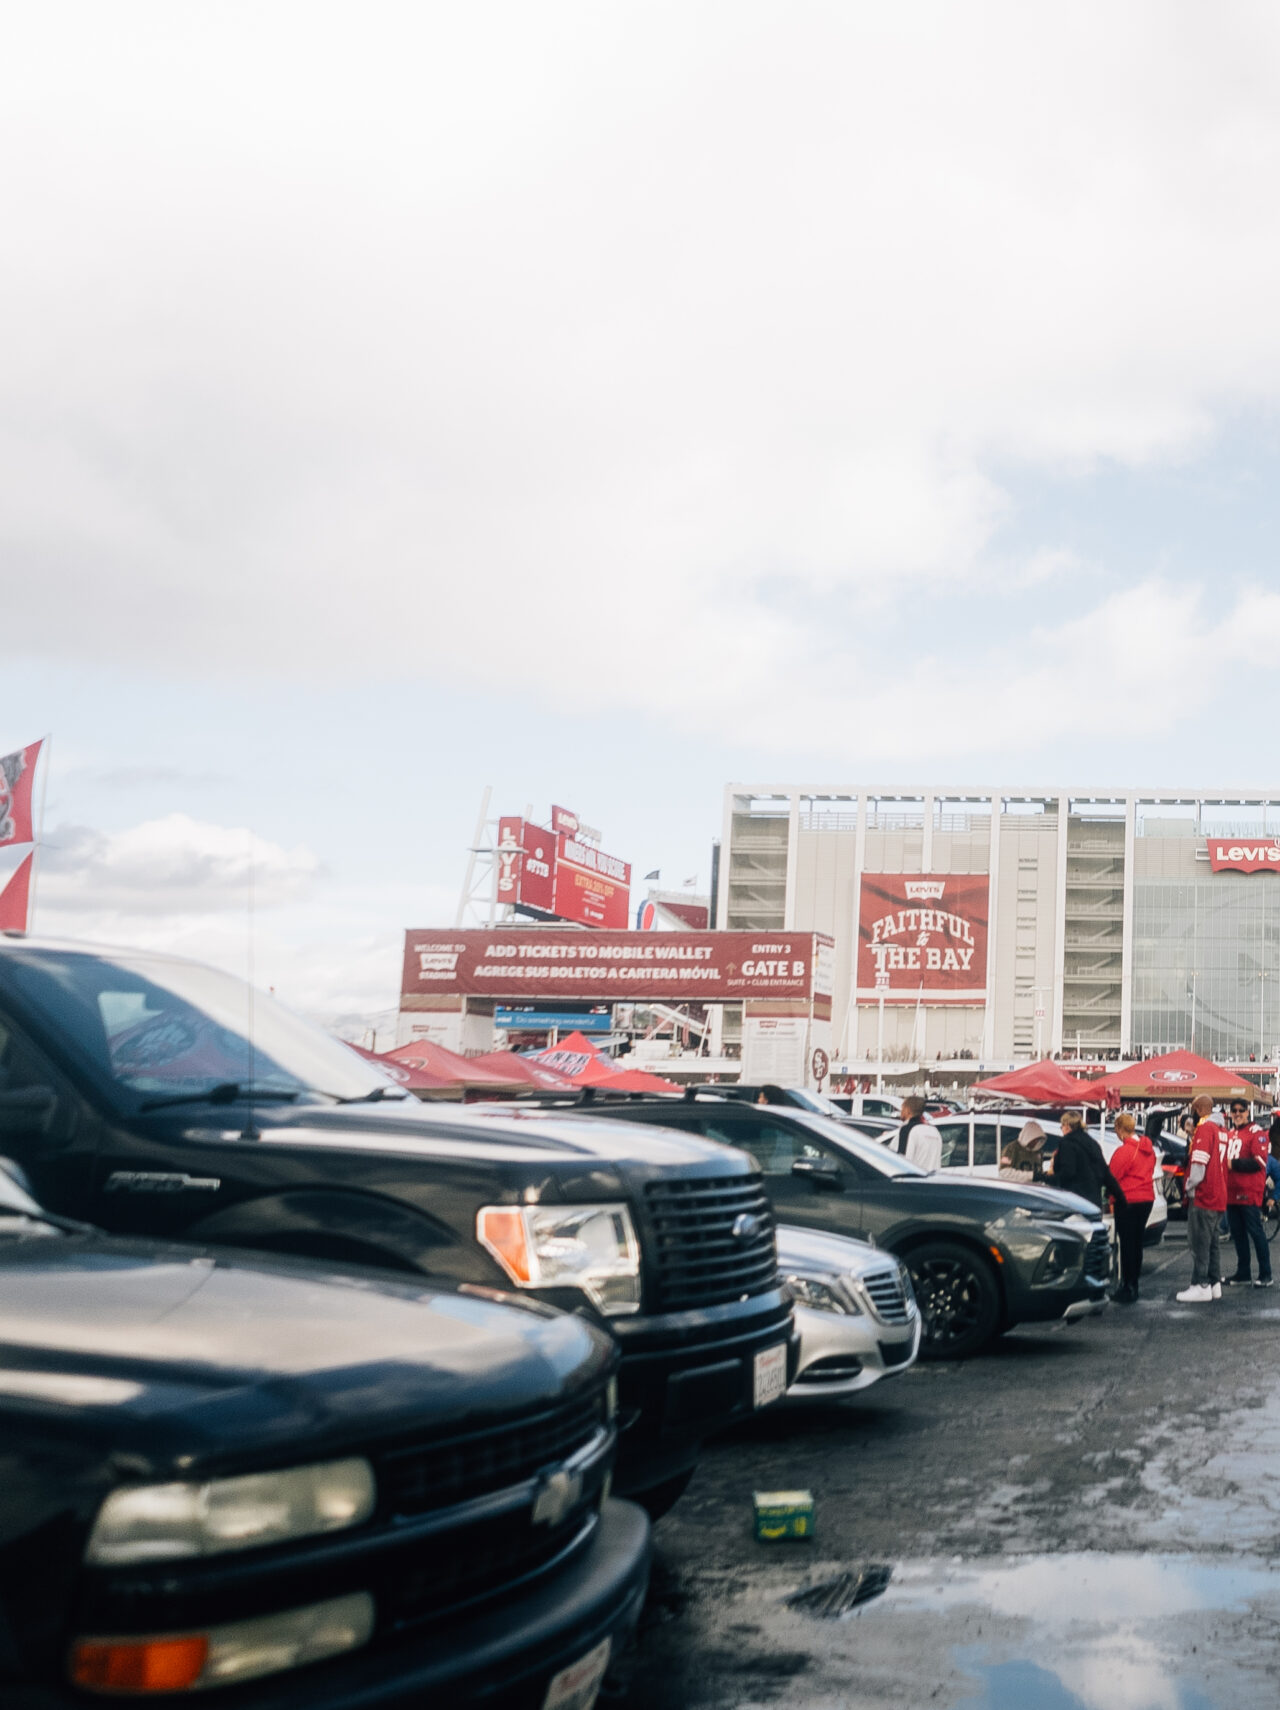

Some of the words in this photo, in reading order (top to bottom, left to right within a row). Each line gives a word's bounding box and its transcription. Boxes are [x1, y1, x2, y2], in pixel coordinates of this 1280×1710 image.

[872, 908, 975, 947] FAITHFUL
[485, 945, 517, 959] ADD
[518, 945, 577, 959] TICKETS
[577, 945, 598, 959] TO
[598, 947, 655, 960] MOBILE
[655, 946, 713, 960] WALLET
[752, 944, 782, 954] ENTRY
[783, 945, 792, 954] 3
[871, 947, 921, 970] THE
[925, 947, 975, 971] BAY
[473, 966, 524, 978] AGREGE
[524, 966, 549, 978] SUS
[551, 966, 607, 979] BOLETOS
[607, 967, 619, 979] A
[619, 967, 678, 980] CARTERA
[678, 965, 721, 980] MÓVIL
[741, 960, 788, 977] GATE
[792, 961, 805, 977] B
[727, 978, 745, 987] SUITE
[751, 979, 769, 987] CLUB
[769, 979, 804, 987] ENTRANCE
